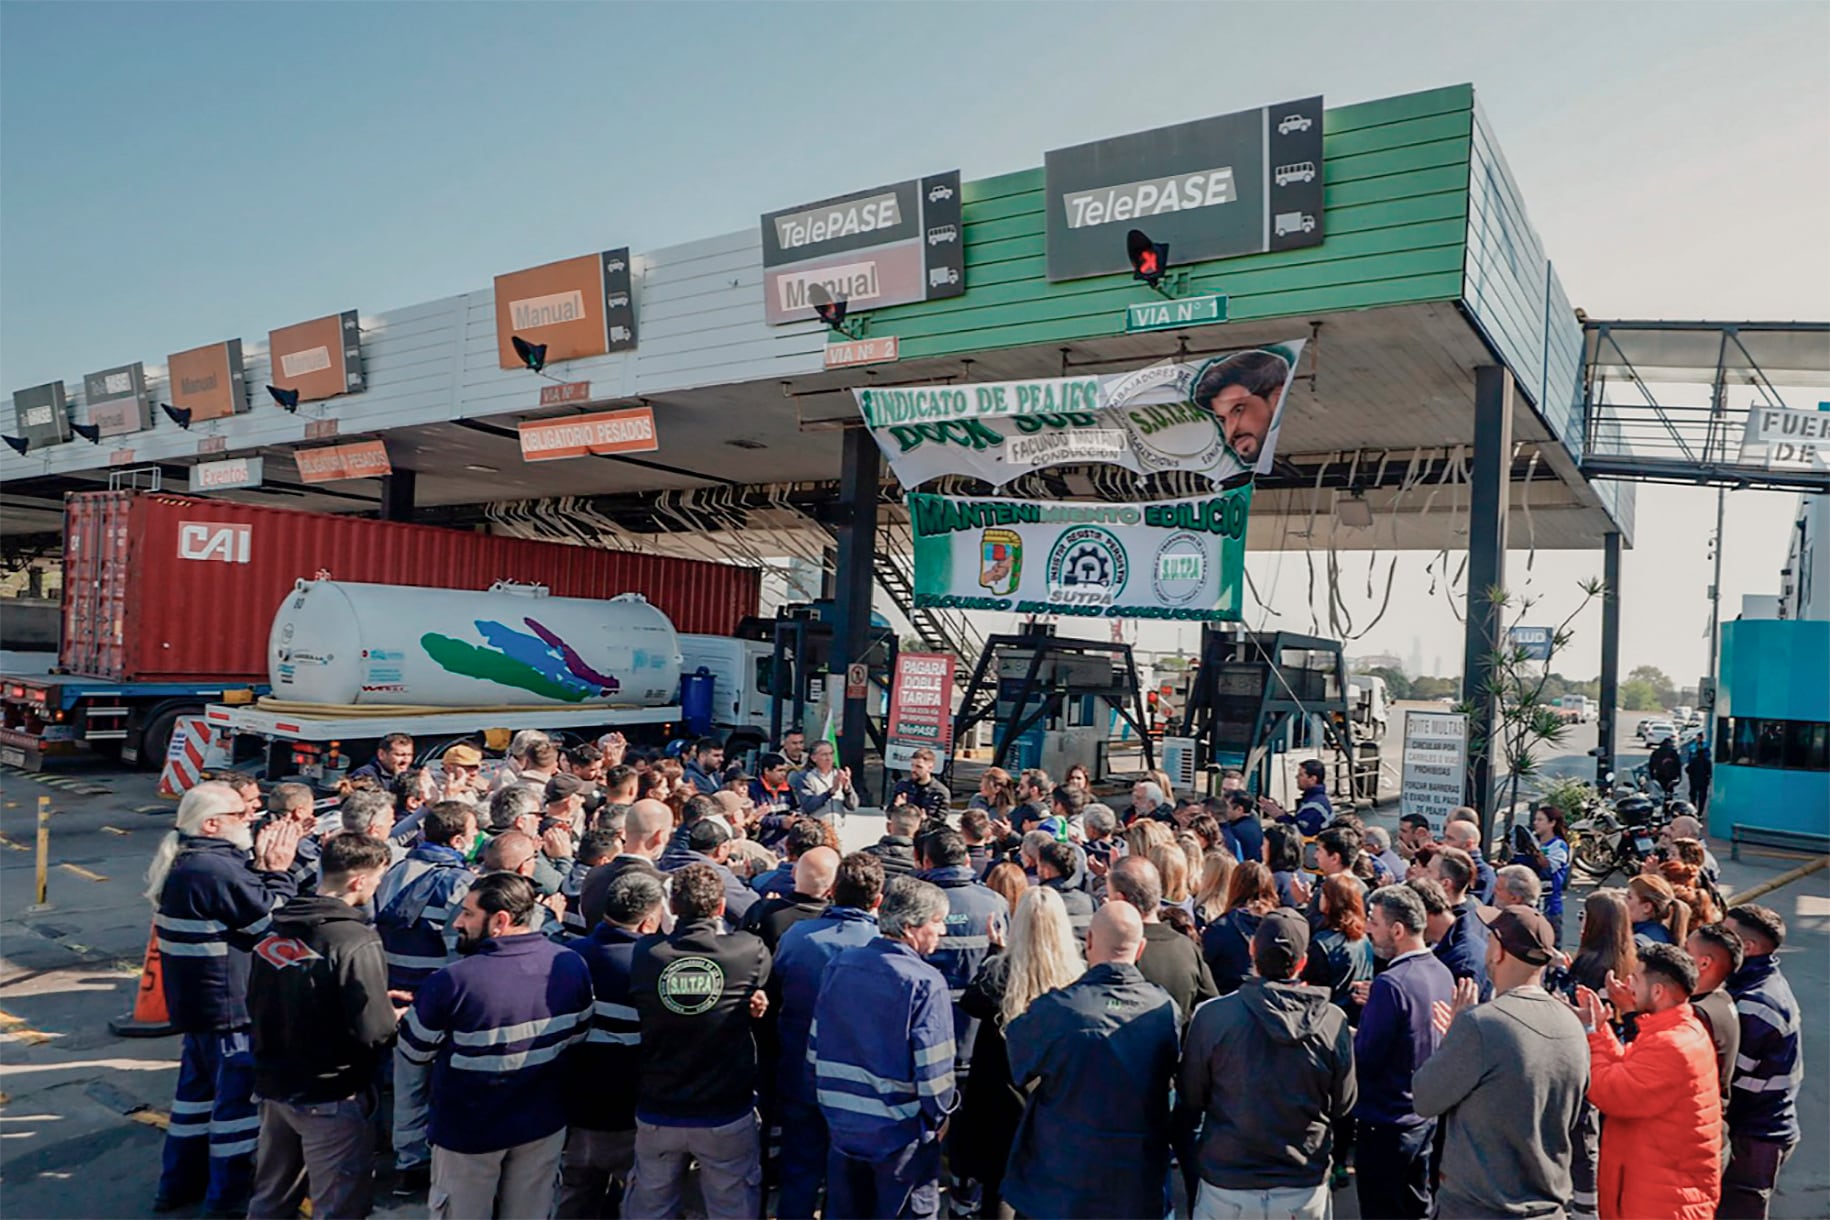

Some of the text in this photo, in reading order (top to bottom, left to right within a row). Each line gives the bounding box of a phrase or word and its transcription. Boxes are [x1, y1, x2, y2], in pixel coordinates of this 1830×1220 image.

[1071, 169, 1232, 228] TelePASE
[781, 199, 896, 250] TelePASE
[515, 293, 579, 329] Manual
[1136, 305, 1171, 327] VIA
[1209, 299, 1218, 318] 1
[829, 346, 854, 365] VIA
[884, 340, 896, 358] 2
[862, 389, 968, 428] SINDICATO
[975, 386, 1009, 413] DE
[523, 417, 652, 451] OBLIGATORIO PESADOS
[889, 418, 1004, 453] DOCK
[1011, 432, 1069, 462] FACUNDO
[1774, 442, 1816, 464] DE
[202, 466, 249, 485] Exentos
[916, 493, 1248, 539] MANTENIMIENTO EDILICIO
[181, 524, 251, 563] CAI
[1049, 589, 1113, 605] SUTPA
[901, 690, 941, 707] TARIFA
[904, 676, 942, 691] DOBLE
